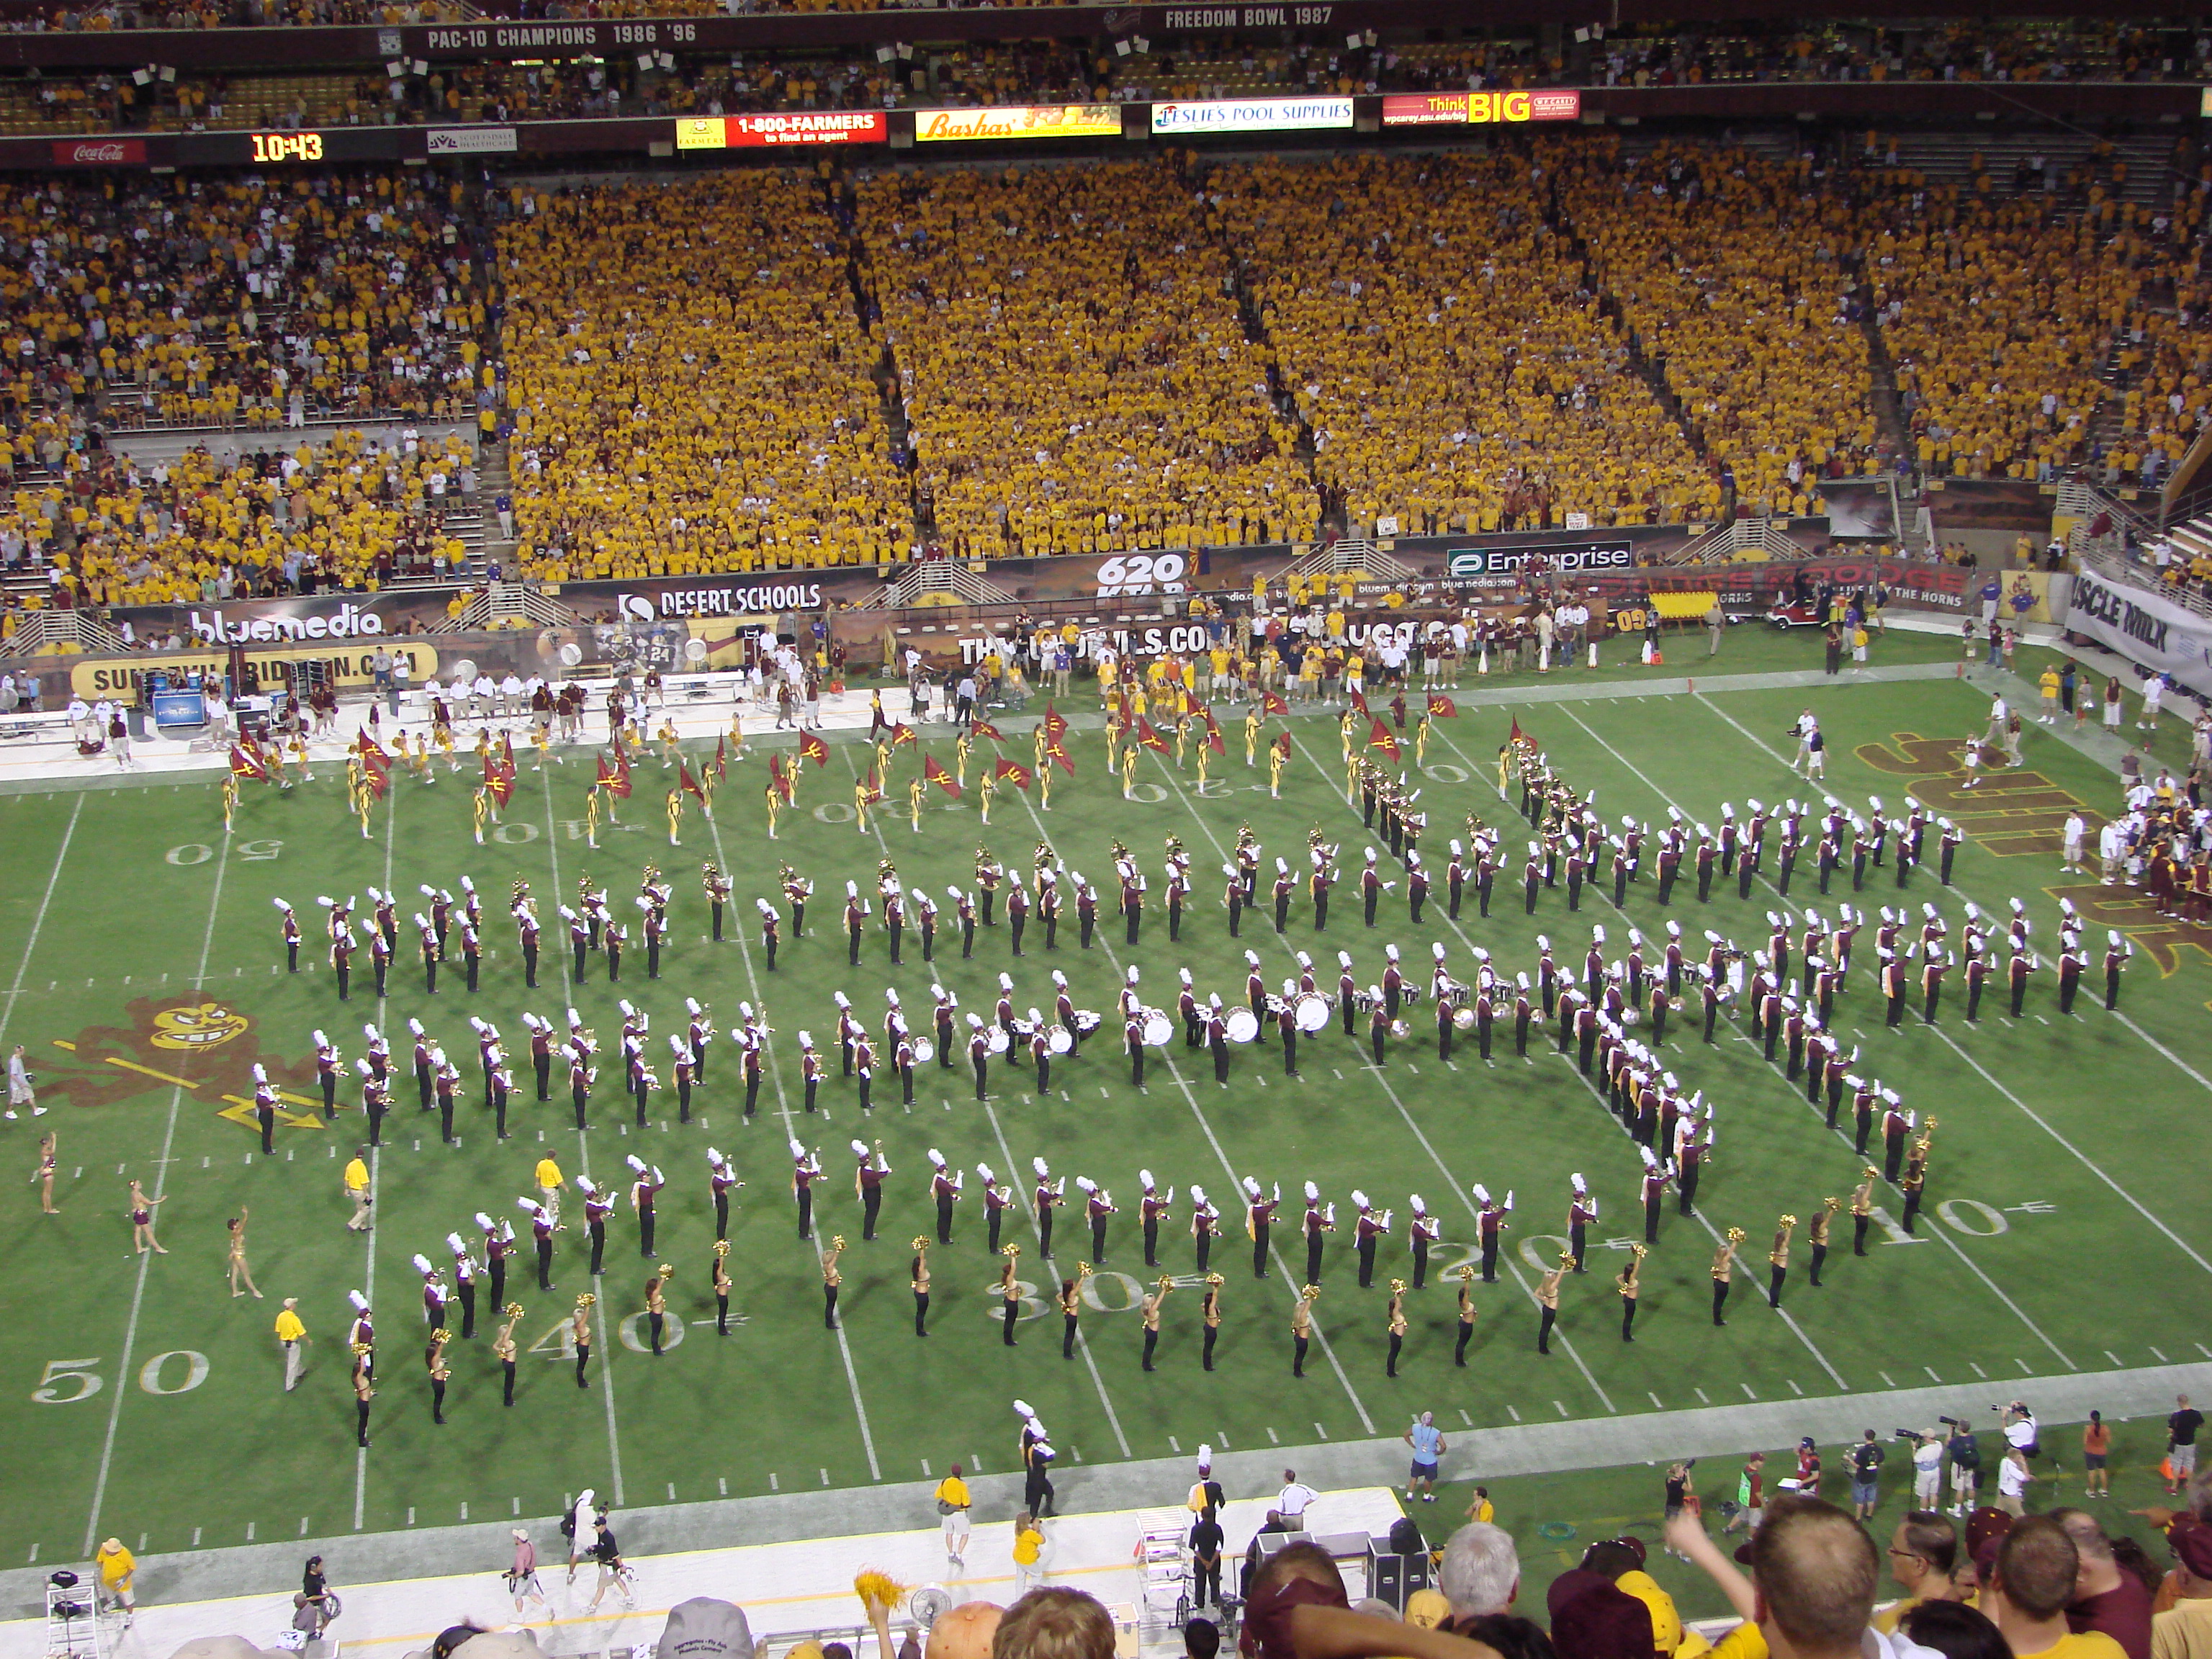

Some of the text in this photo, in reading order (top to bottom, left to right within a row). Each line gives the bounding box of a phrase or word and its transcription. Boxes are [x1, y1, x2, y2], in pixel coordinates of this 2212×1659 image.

[1166, 6, 1332, 28] FREEDOM BOWL 1987
[428, 24, 696, 48] PAC-10 CHAMPIONS 1986 '96
[1162, 104, 1351, 123] LESLIE'S POOL SUPPLIES
[1383, 112, 1467, 125] wpcarey.asu.edu/big
[1426, 92, 1531, 123] Think BIG
[738, 114, 875, 134] 1-800-FARMERS
[925, 113, 1016, 138] Bashas'
[252, 133, 323, 162] 10:43
[764, 134, 775, 143] to
[778, 132, 800, 142] find
[817, 132, 848, 142] agent
[1097, 554, 1184, 585] 620
[1488, 546, 1629, 572] Entrprise
[661, 584, 821, 615] DESERT SCHOOLS
[1719, 592, 1753, 604] ORNS
[1894, 586, 1917, 600] THE
[1921, 591, 1962, 608] HORNS
[191, 603, 383, 644] bluemedia
[650, 647, 670, 662] 24
[31, 1349, 210, 1403] 50
